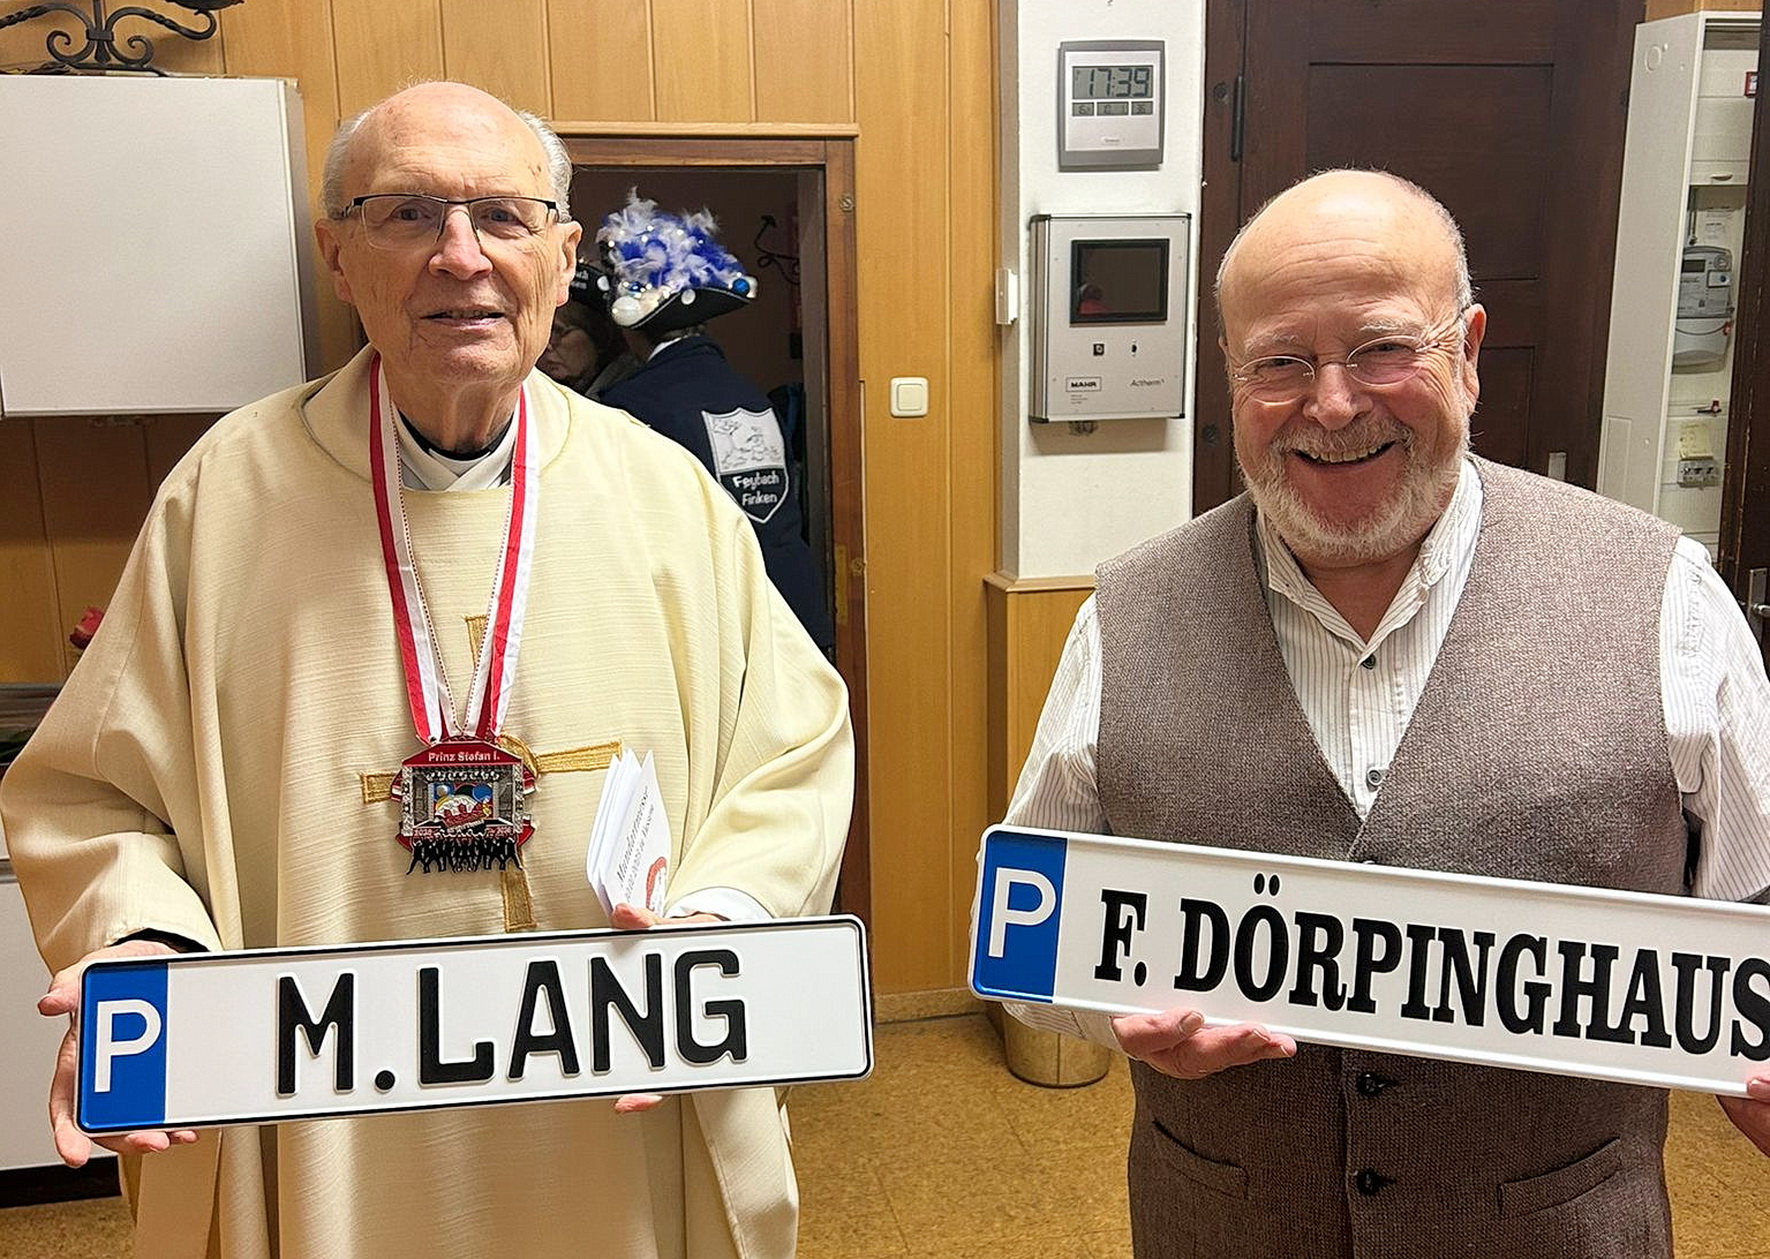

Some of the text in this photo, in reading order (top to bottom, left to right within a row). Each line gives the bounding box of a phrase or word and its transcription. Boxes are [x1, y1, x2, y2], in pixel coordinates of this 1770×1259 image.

[1089, 67, 1150, 97] 17:39
[741, 490, 778, 506] Finken
[428, 750, 501, 762] Prinz Stefan I.
[987, 866, 1057, 958] P
[1094, 872, 1770, 1062] F. DÖRPINGHAUS
[94, 998, 161, 1093] P
[276, 949, 748, 1095] M.LANG
